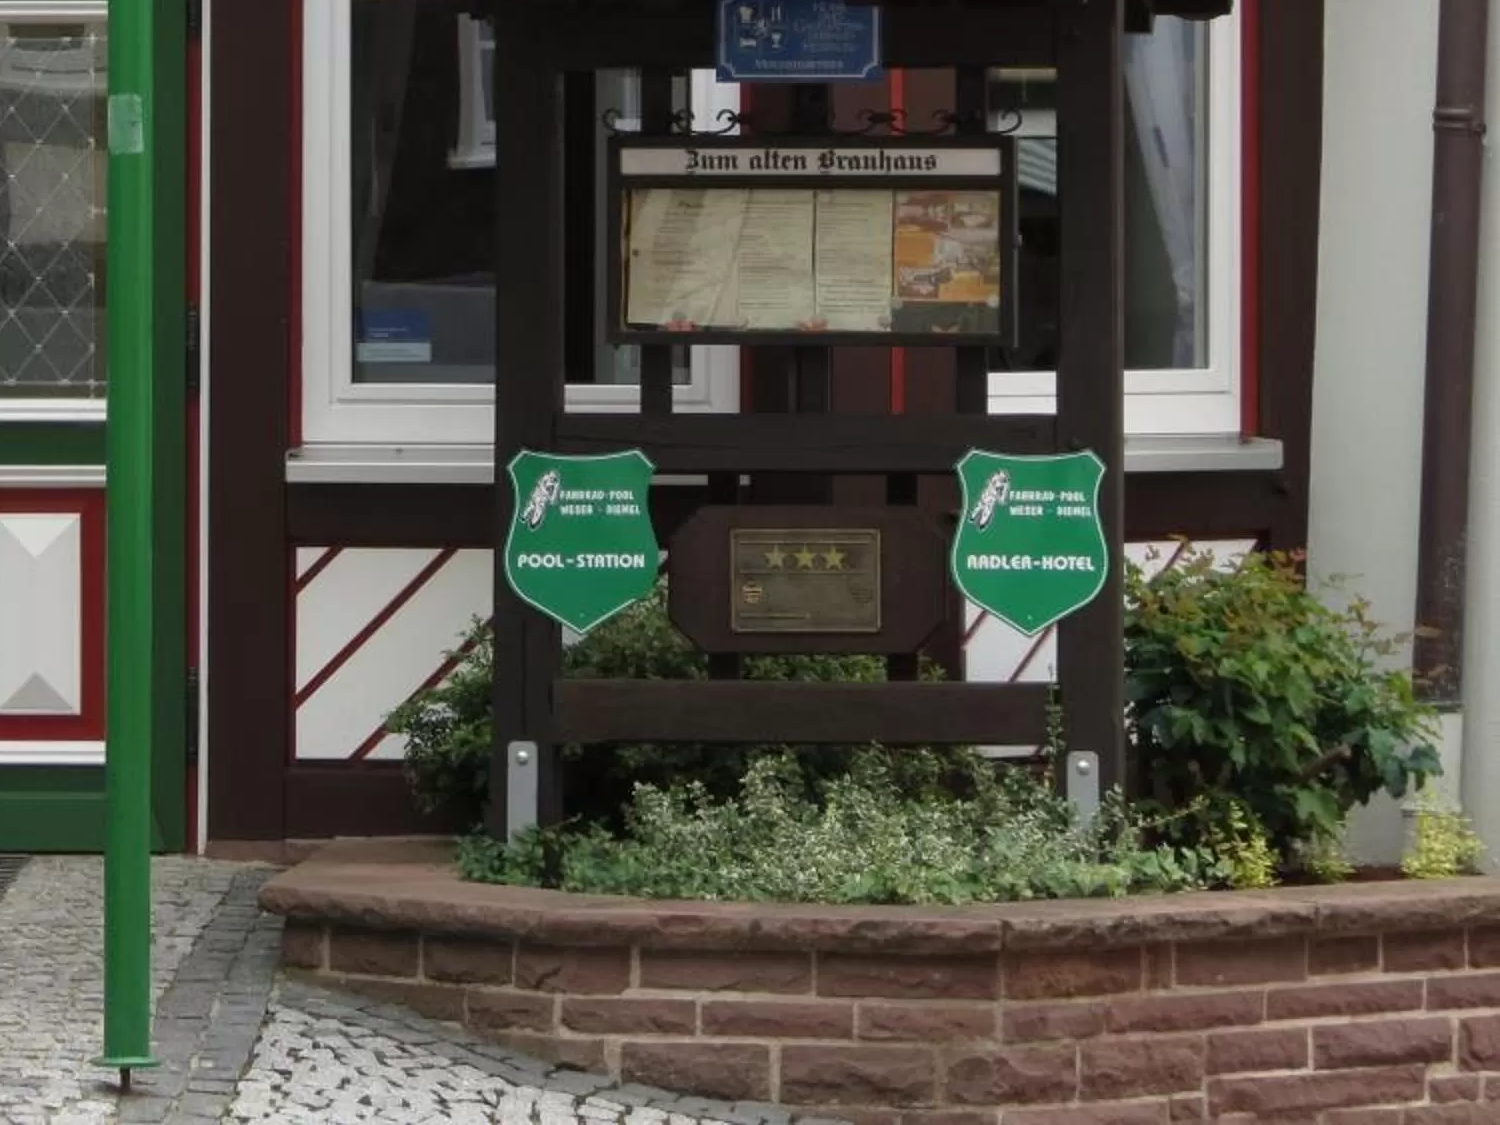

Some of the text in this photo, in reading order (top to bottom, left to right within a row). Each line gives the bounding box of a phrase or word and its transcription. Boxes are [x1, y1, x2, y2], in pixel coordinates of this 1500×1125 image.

[684, 148, 937, 174] Zum alten Brauhaus
[516, 553, 646, 569] POOL-STATION
